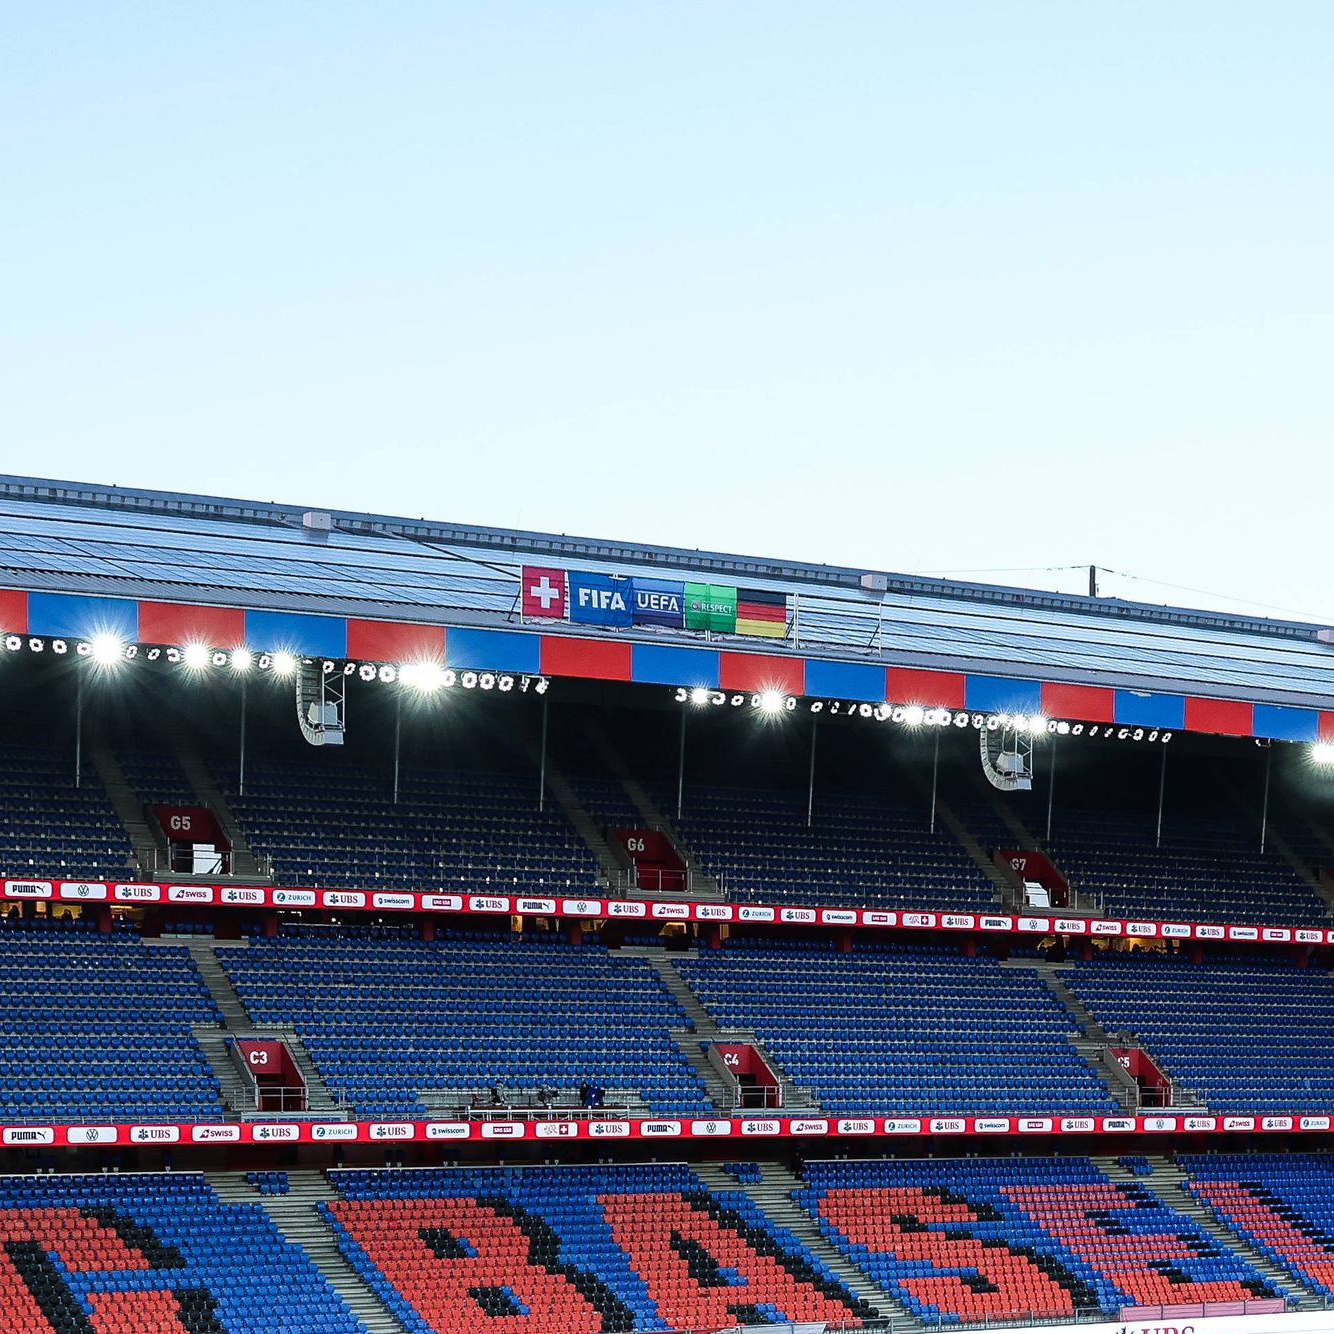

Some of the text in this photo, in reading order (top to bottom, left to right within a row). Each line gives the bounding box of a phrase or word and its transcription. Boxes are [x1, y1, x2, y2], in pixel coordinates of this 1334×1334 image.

[578, 588, 626, 611] FIFA
[637, 593, 679, 612] UEFA
[701, 603, 732, 614] RESPECT
[171, 816, 191, 831] G5
[627, 838, 644, 852] G6
[1011, 858, 1026, 871] G7
[12, 885, 36, 893] PUMA
[132, 889, 153, 897] UBS
[238, 892, 257, 900] UBS
[340, 895, 359, 904] UBS
[485, 900, 503, 908] UBS
[250, 1050, 268, 1065] C3
[271, 1129, 291, 1137] UBS
[387, 1127, 407, 1135] UBS
[605, 1125, 623, 1133] UBS
[10, 1132, 36, 1140] PUMA
[149, 1130, 171, 1138] UBS
